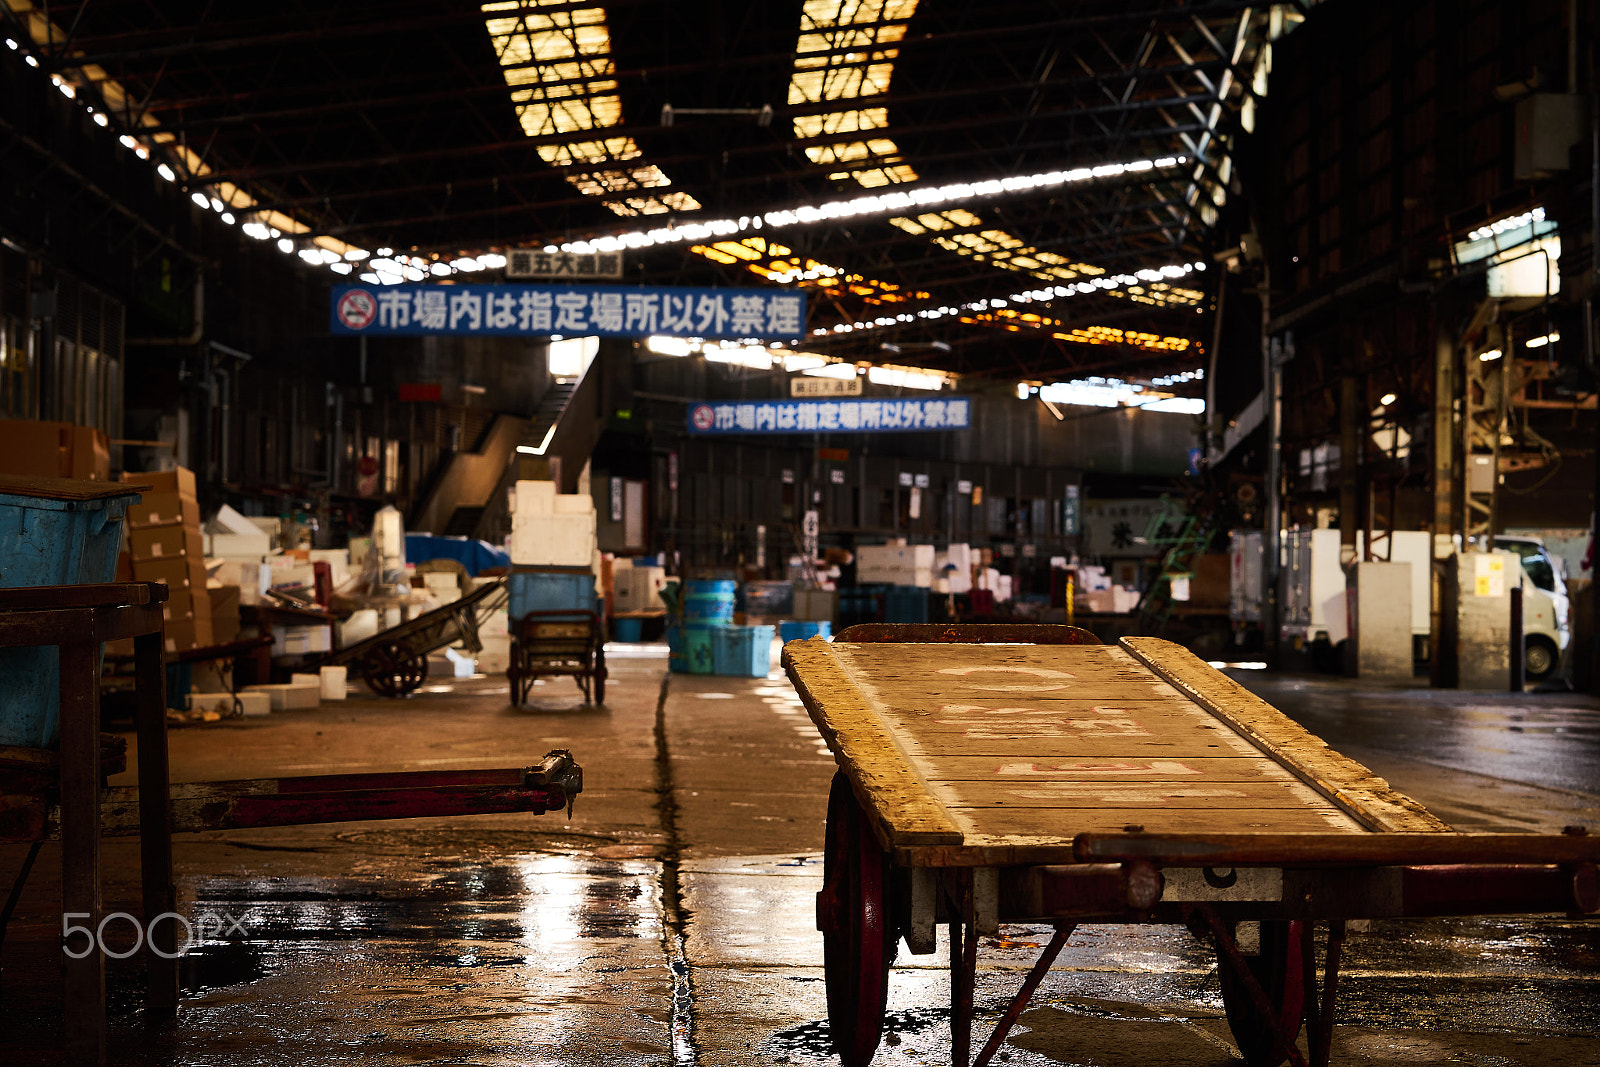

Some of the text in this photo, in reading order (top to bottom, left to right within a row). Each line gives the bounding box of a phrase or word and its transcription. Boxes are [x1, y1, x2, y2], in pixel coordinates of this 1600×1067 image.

[377, 289, 800, 334] 市場内は指定場所以外禁煙
[714, 400, 968, 430] 市場内は指定場所以外禁煙
